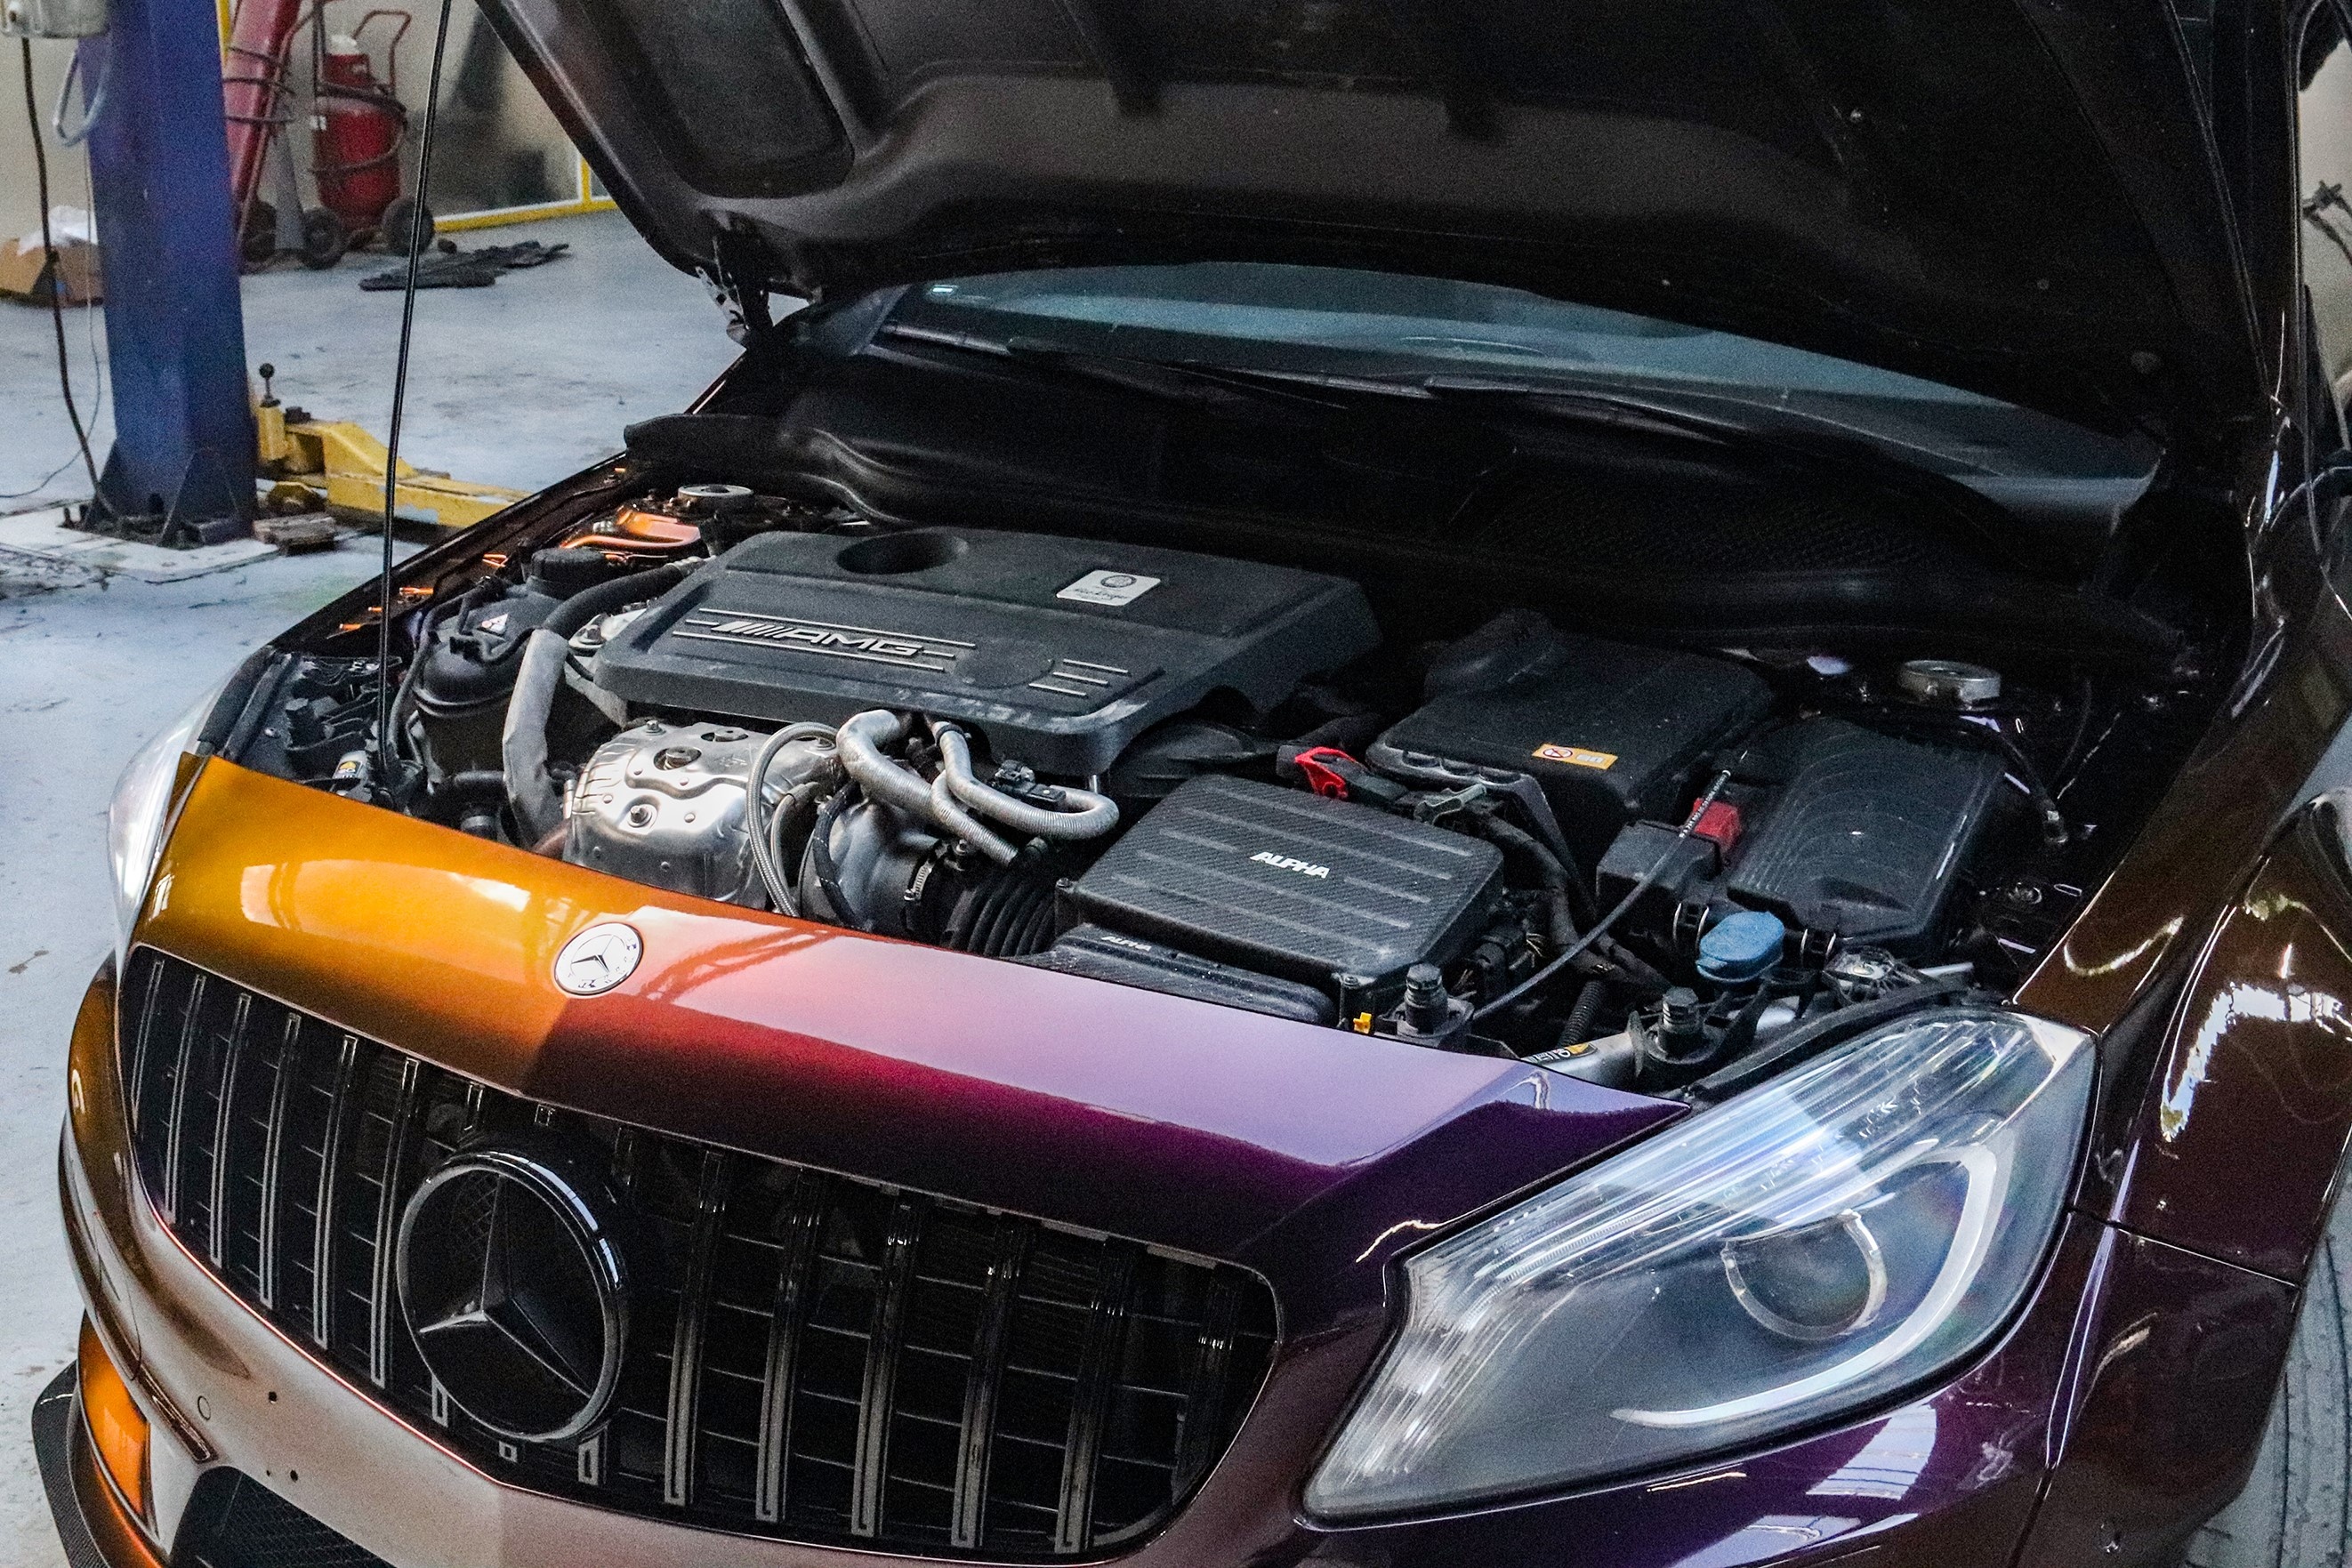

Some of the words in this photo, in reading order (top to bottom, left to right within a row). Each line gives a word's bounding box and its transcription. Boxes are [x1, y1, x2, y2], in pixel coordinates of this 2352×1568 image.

[773, 627, 923, 656] AMG
[1249, 851, 1330, 879] ALPHA
[1100, 936, 1152, 952] ALPHA
